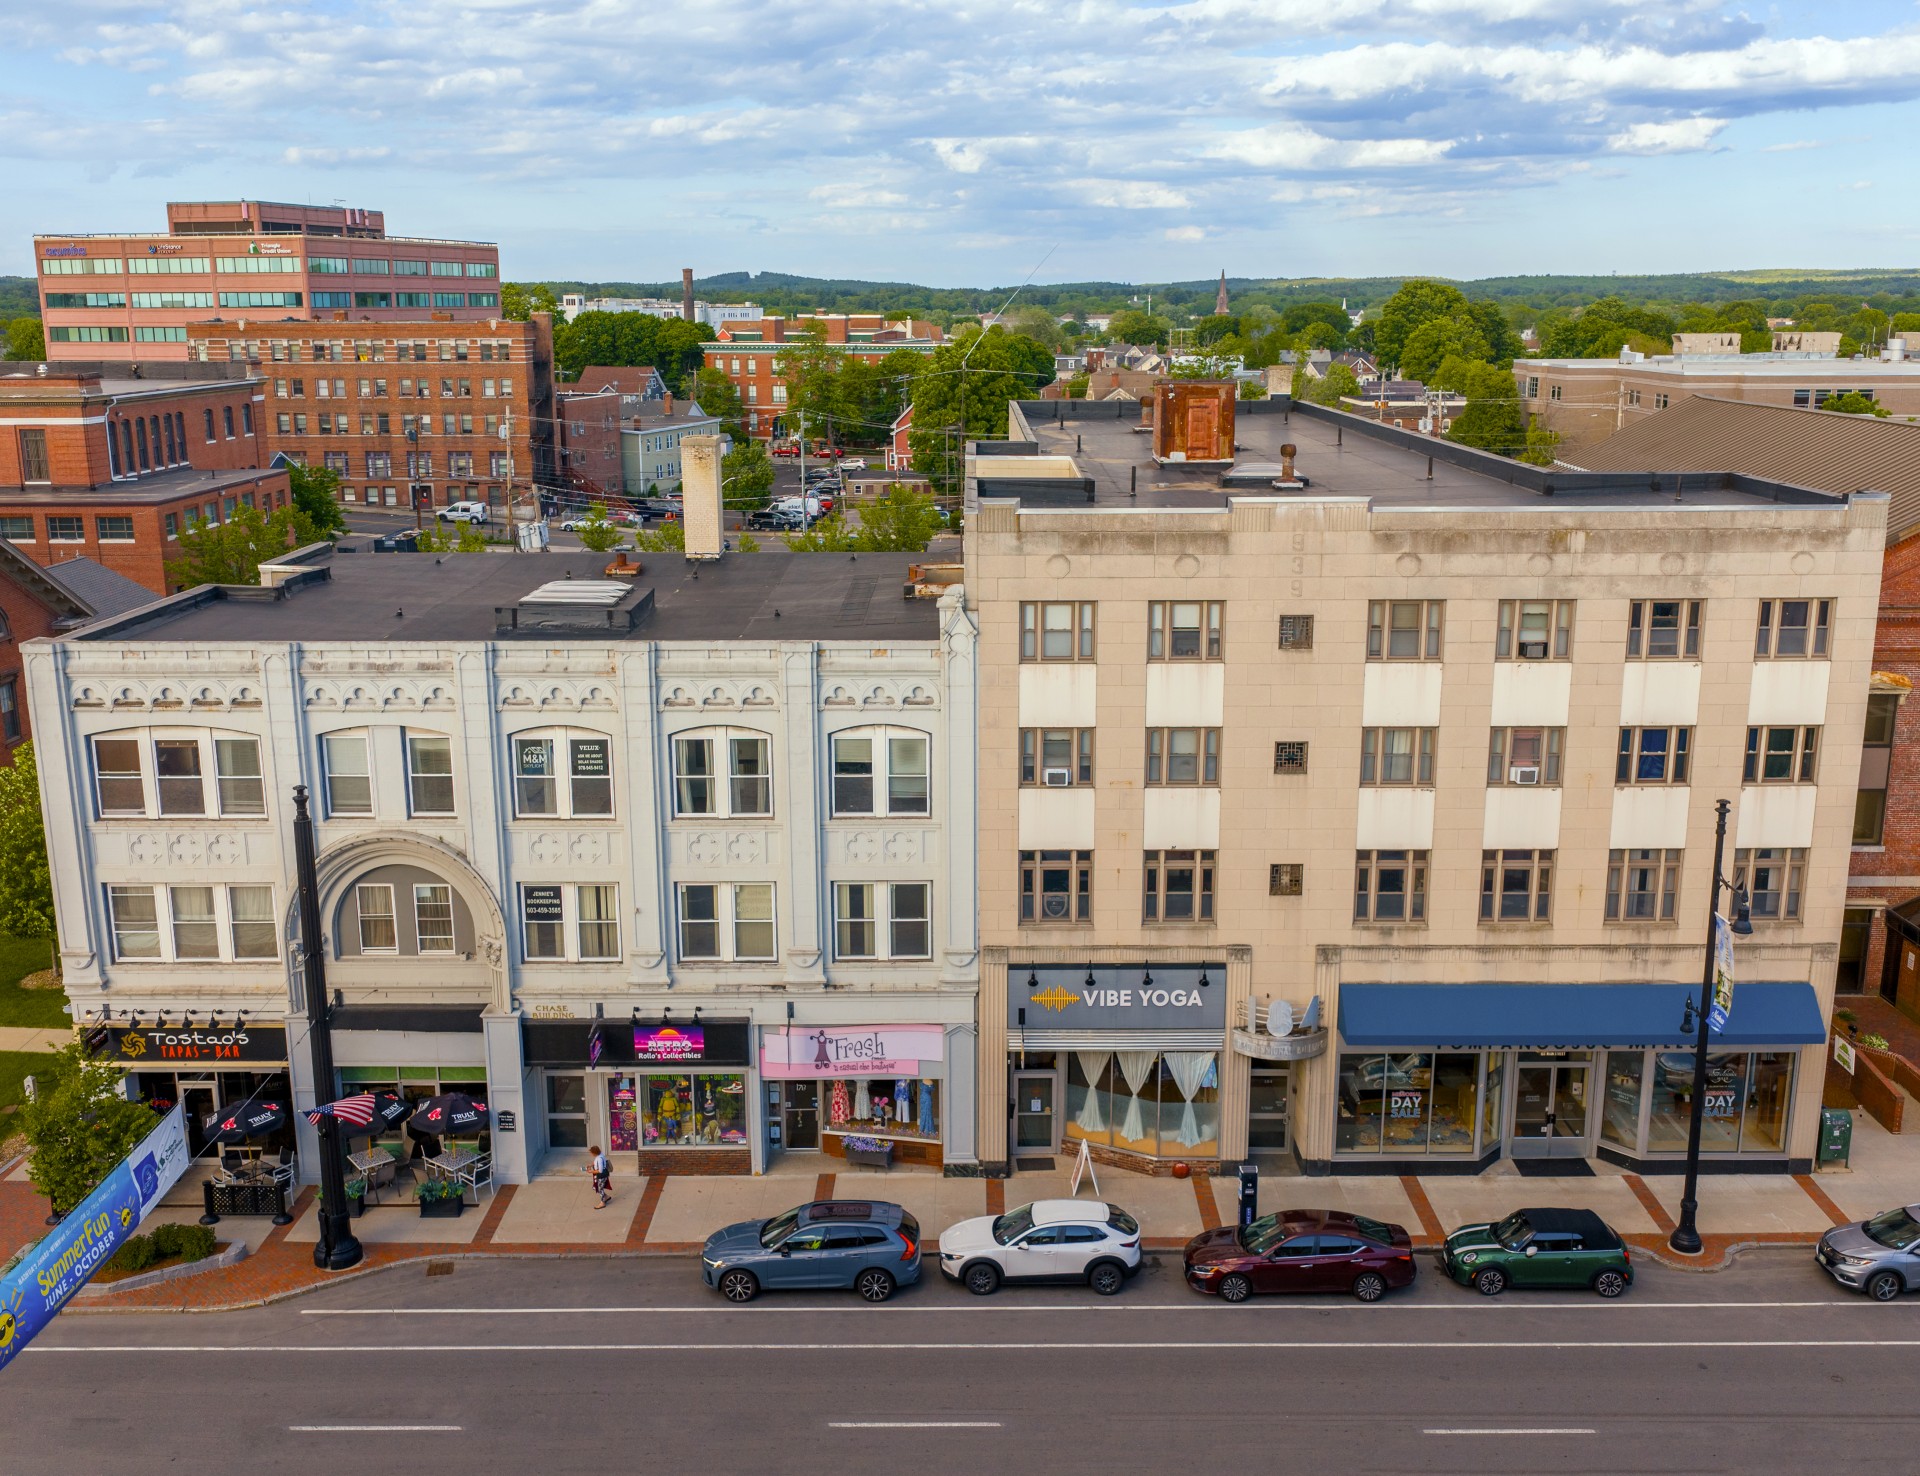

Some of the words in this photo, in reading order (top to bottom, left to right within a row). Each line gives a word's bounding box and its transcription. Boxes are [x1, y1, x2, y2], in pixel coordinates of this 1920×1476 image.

[523, 754, 547, 764] M&M
[1083, 990, 1132, 1006] VIBE
[1138, 990, 1203, 1006] YOGA
[148, 1031, 249, 1045] Tostao's
[161, 1046, 199, 1058] TAPAS
[216, 1046, 240, 1057] BAR
[648, 1040, 692, 1052] RETRO
[835, 1033, 885, 1060] Fresh
[840, 1063, 858, 1071] casual
[1391, 1097, 1422, 1108] DAY
[1705, 1096, 1735, 1106] DAY
[381, 1102, 399, 1116] TRULY
[452, 1111, 475, 1119] TRULY
[1391, 1108, 1420, 1118] SALE
[1704, 1107, 1734, 1117] SALE
[248, 1111, 271, 1124] TRULY
[45, 1279, 68, 1311] JUNE
[74, 1230, 115, 1277] OCTOBER
